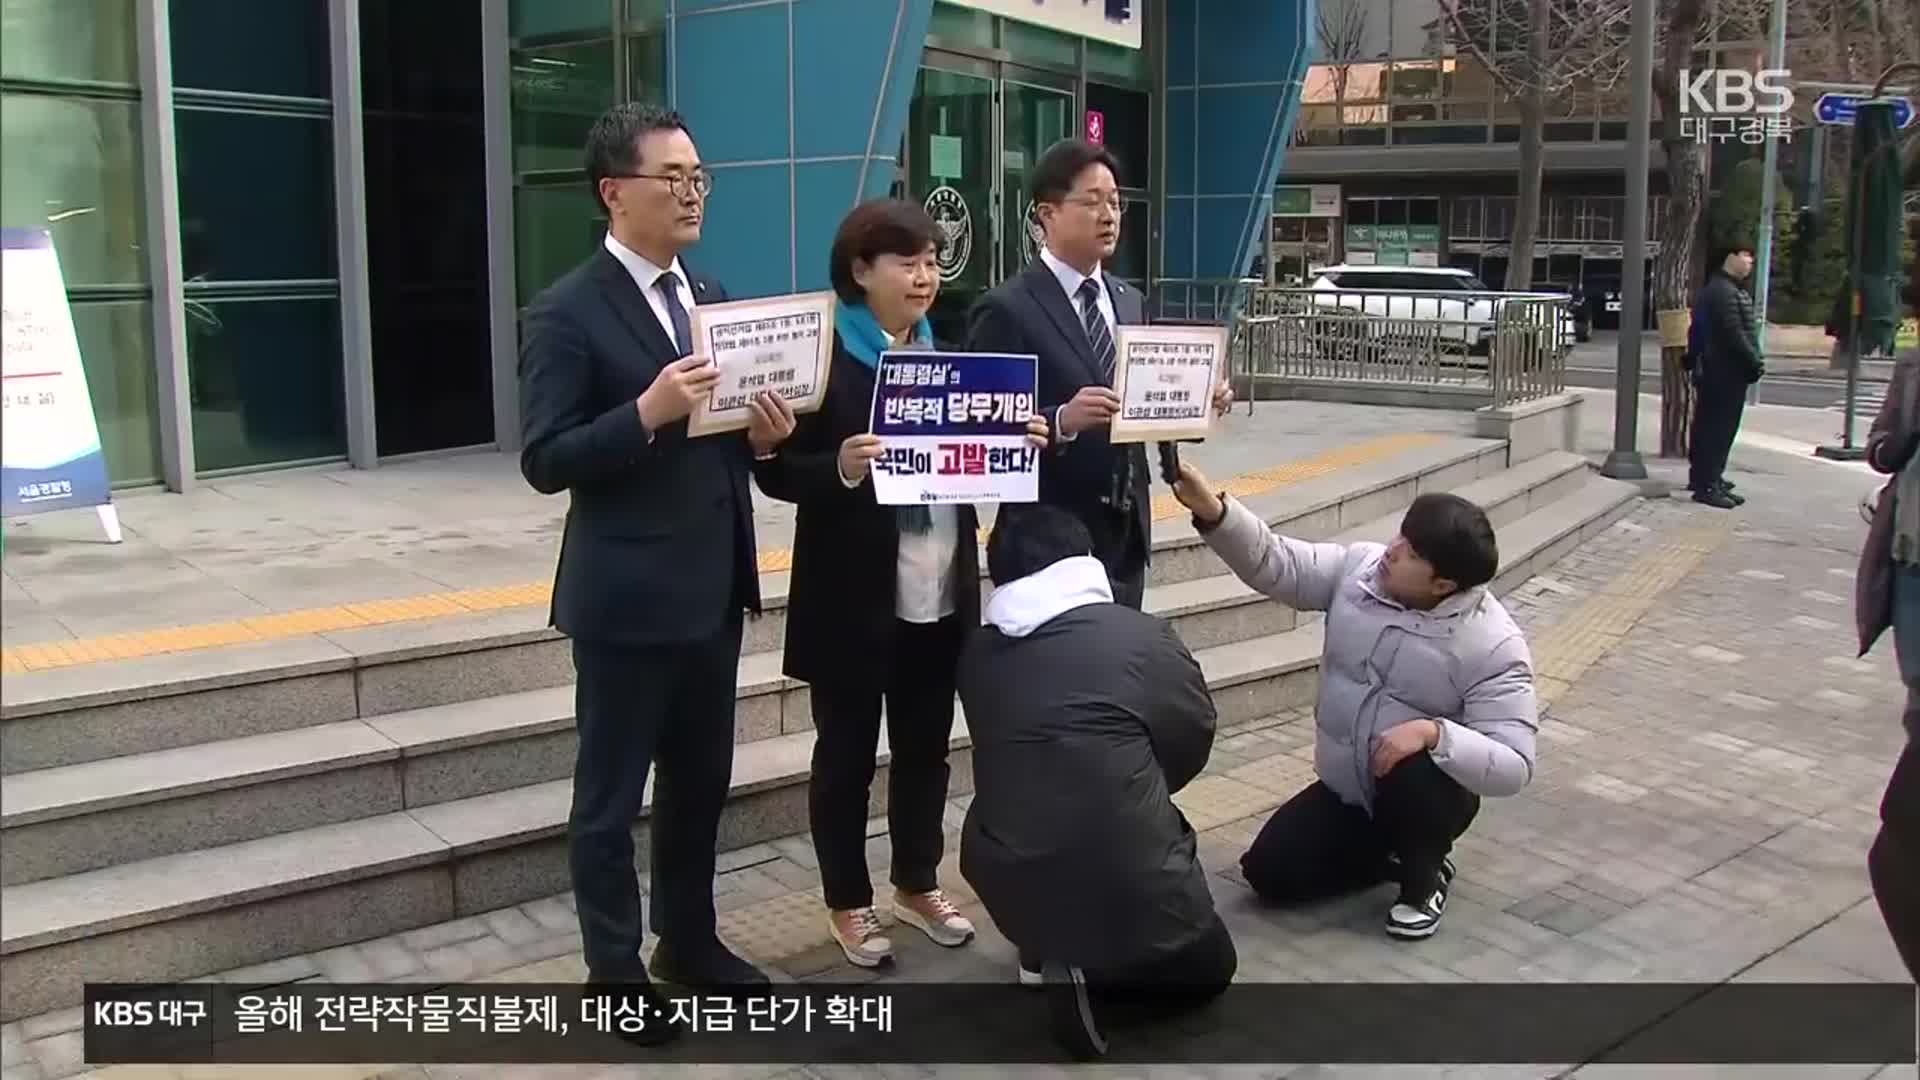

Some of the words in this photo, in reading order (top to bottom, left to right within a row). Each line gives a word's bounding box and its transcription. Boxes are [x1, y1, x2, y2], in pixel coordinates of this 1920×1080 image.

[884, 397, 943, 425] 반복적
[947, 392, 1034, 424] 당무개입
[875, 448, 931, 476] 국민이
[17, 480, 72, 497] 서울경찰청
